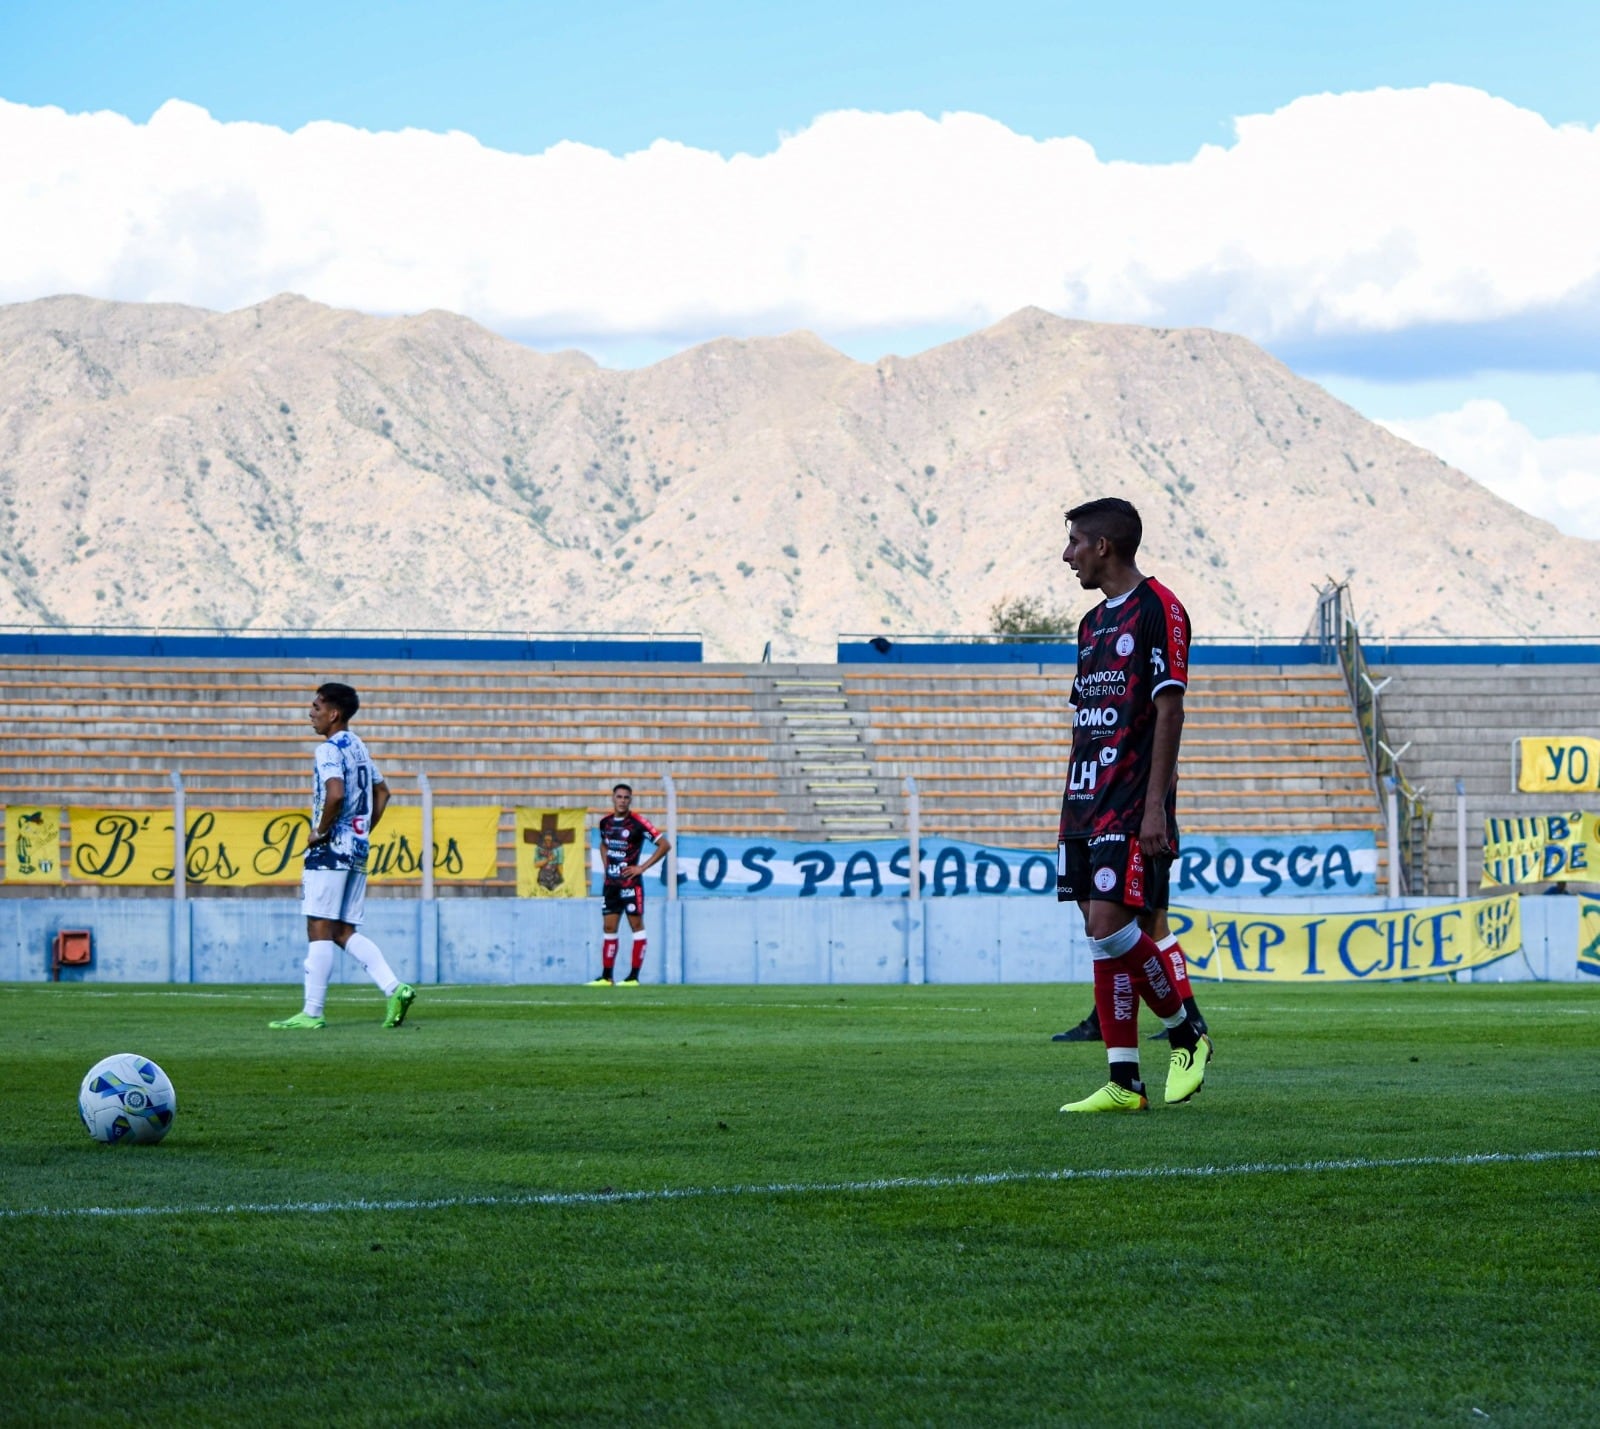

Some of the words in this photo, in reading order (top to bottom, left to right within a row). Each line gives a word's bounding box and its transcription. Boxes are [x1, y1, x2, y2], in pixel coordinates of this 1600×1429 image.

[1069, 761, 1098, 791] LH
[1546, 744, 1589, 785] YO
[1178, 844, 1363, 897] ROSCA
[1543, 842, 1589, 878] DE
[1113, 973, 1133, 994] 2000
[1113, 995, 1133, 1021] SPORT
